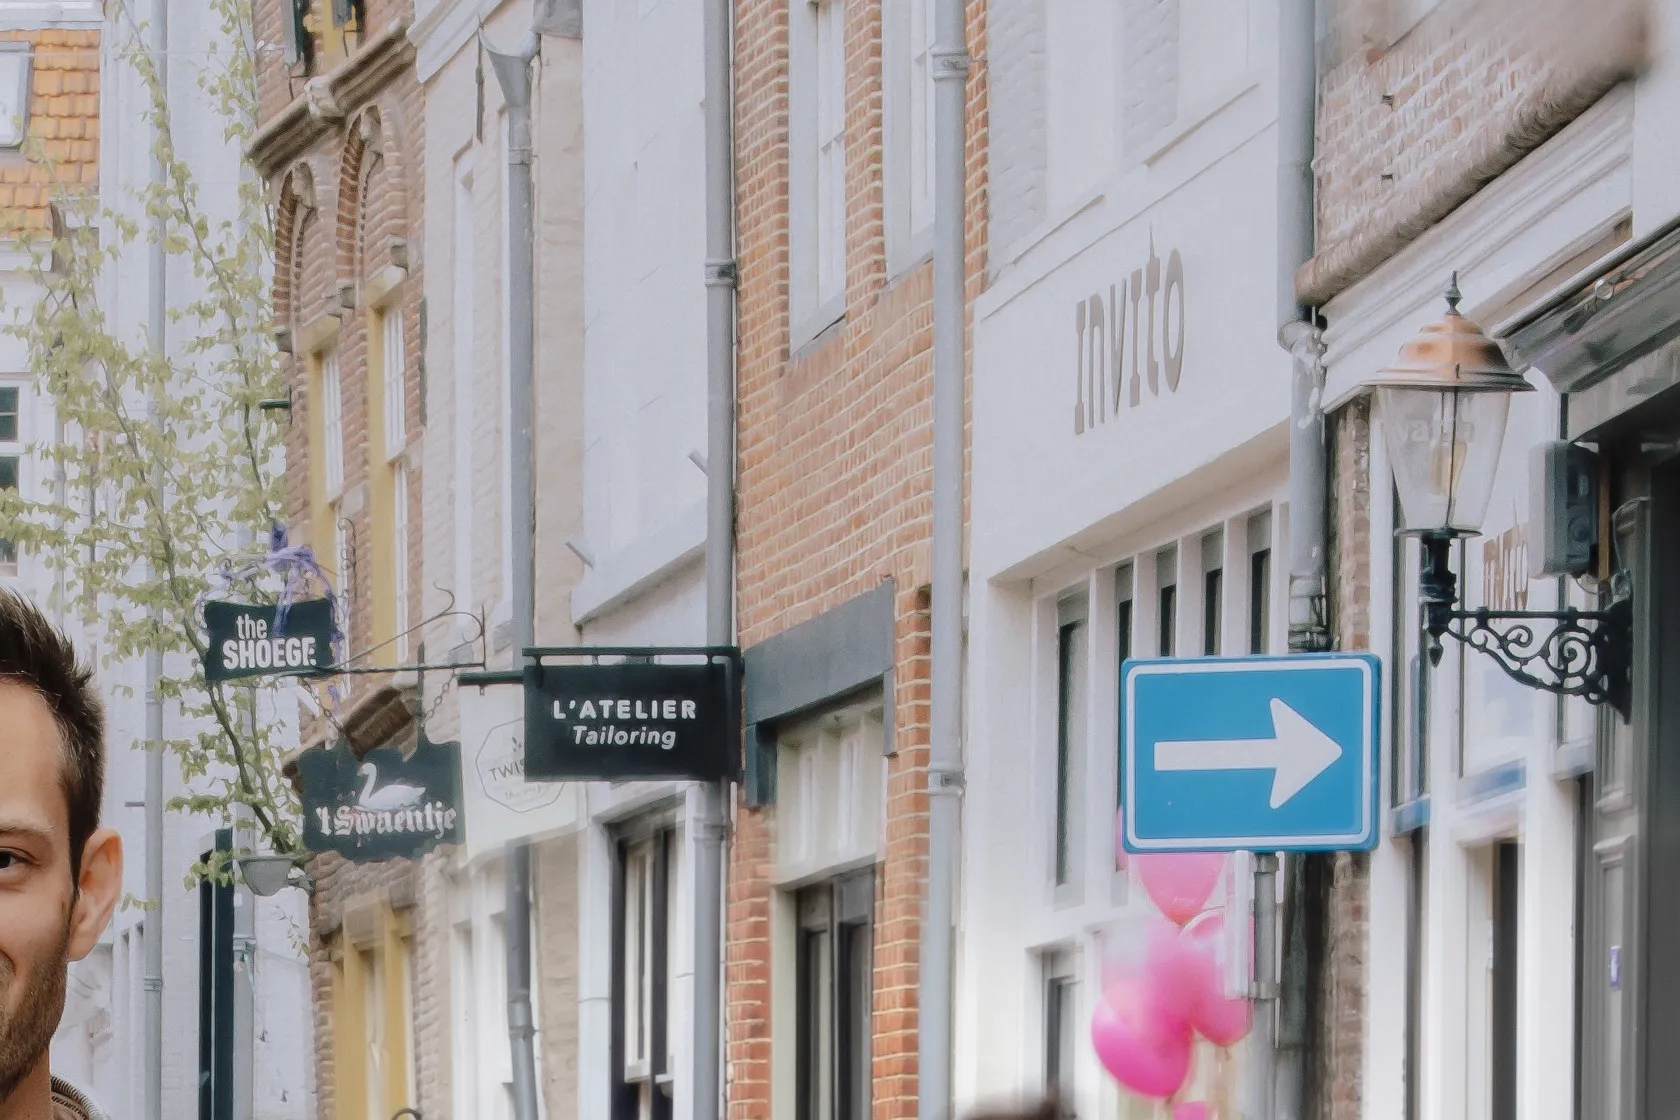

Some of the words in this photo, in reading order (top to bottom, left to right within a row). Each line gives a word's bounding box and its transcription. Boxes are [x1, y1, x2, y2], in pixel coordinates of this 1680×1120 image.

[236, 613, 268, 640] the
[553, 699, 696, 720] L'ATELIER
[572, 725, 677, 750] Tailoring
